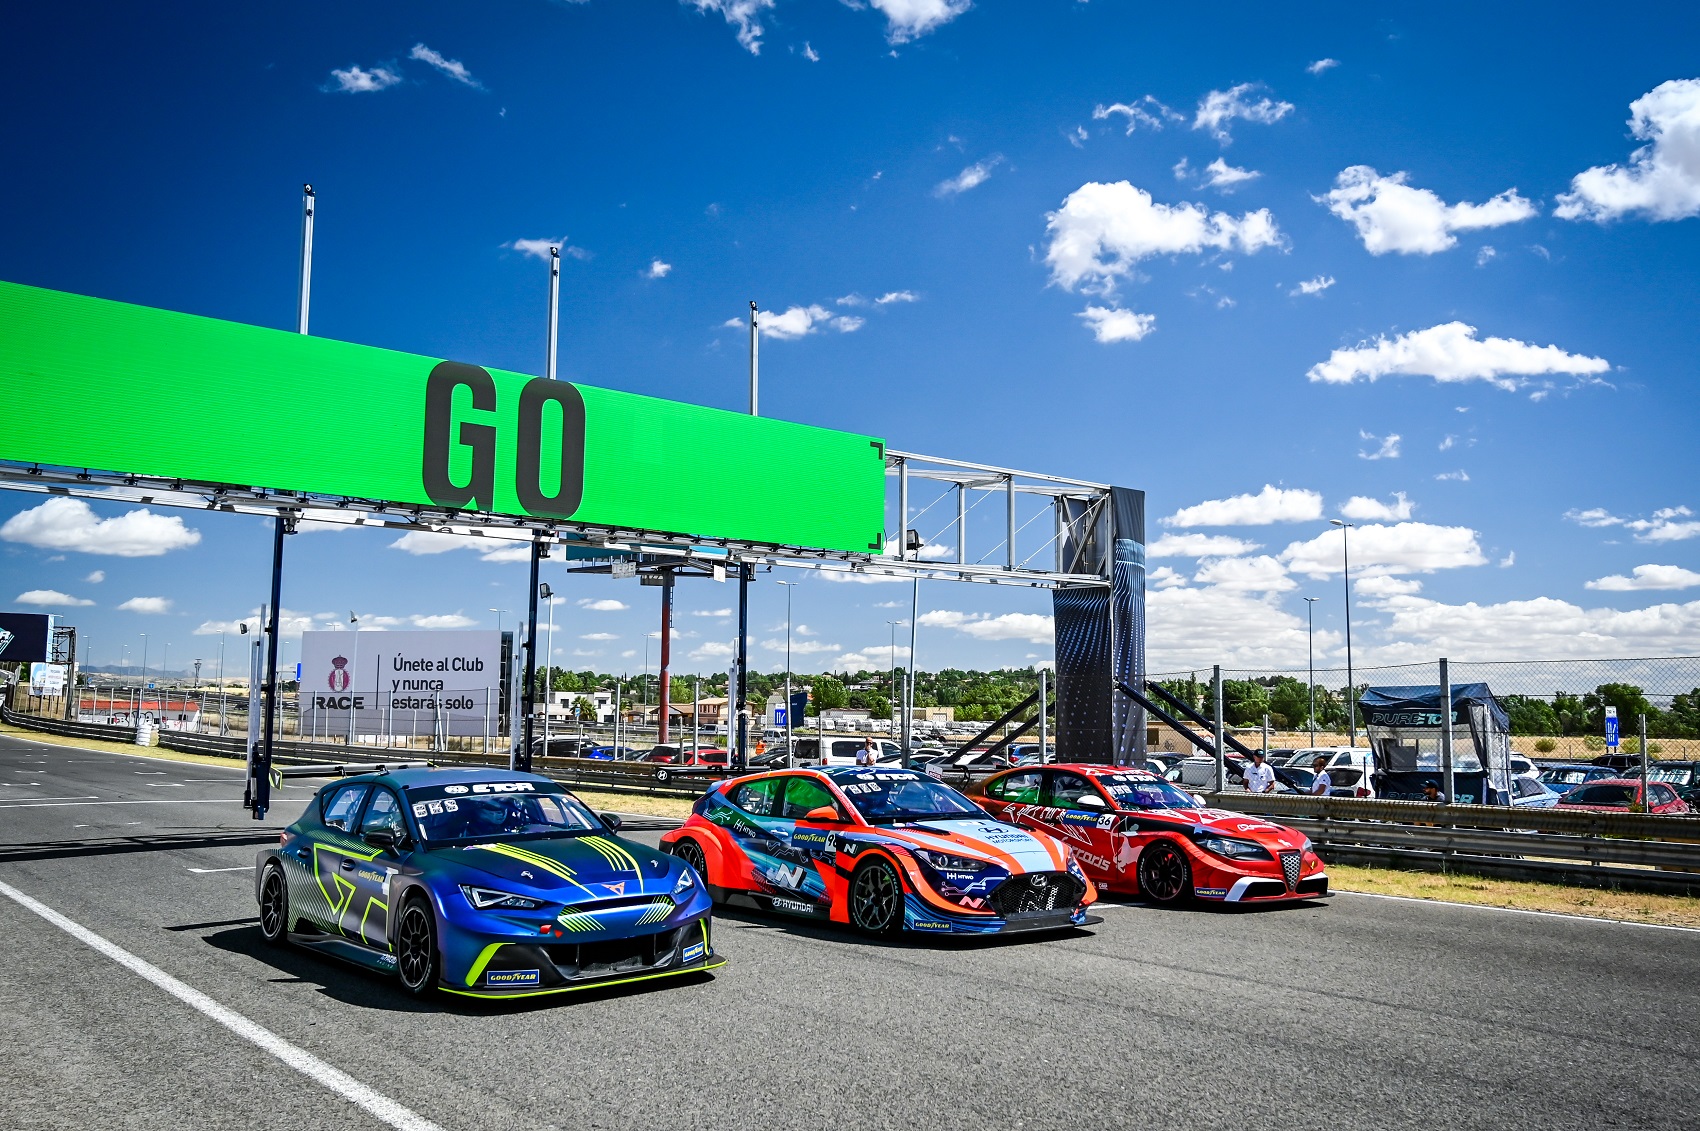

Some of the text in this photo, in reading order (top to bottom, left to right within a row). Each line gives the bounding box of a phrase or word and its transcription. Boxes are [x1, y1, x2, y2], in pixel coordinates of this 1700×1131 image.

[423, 360, 586, 519] GO
[393, 653, 484, 672] Únete al Club
[392, 679, 444, 693] y nunca
[312, 696, 365, 710] RACE
[446, 695, 474, 710] solo
[1098, 815, 1111, 826] 36
[793, 833, 826, 843] GOODYEAR
[782, 899, 814, 913] HYUNDAI
[915, 921, 950, 929] GOODYEAR
[490, 972, 536, 982] GOODYEAR
